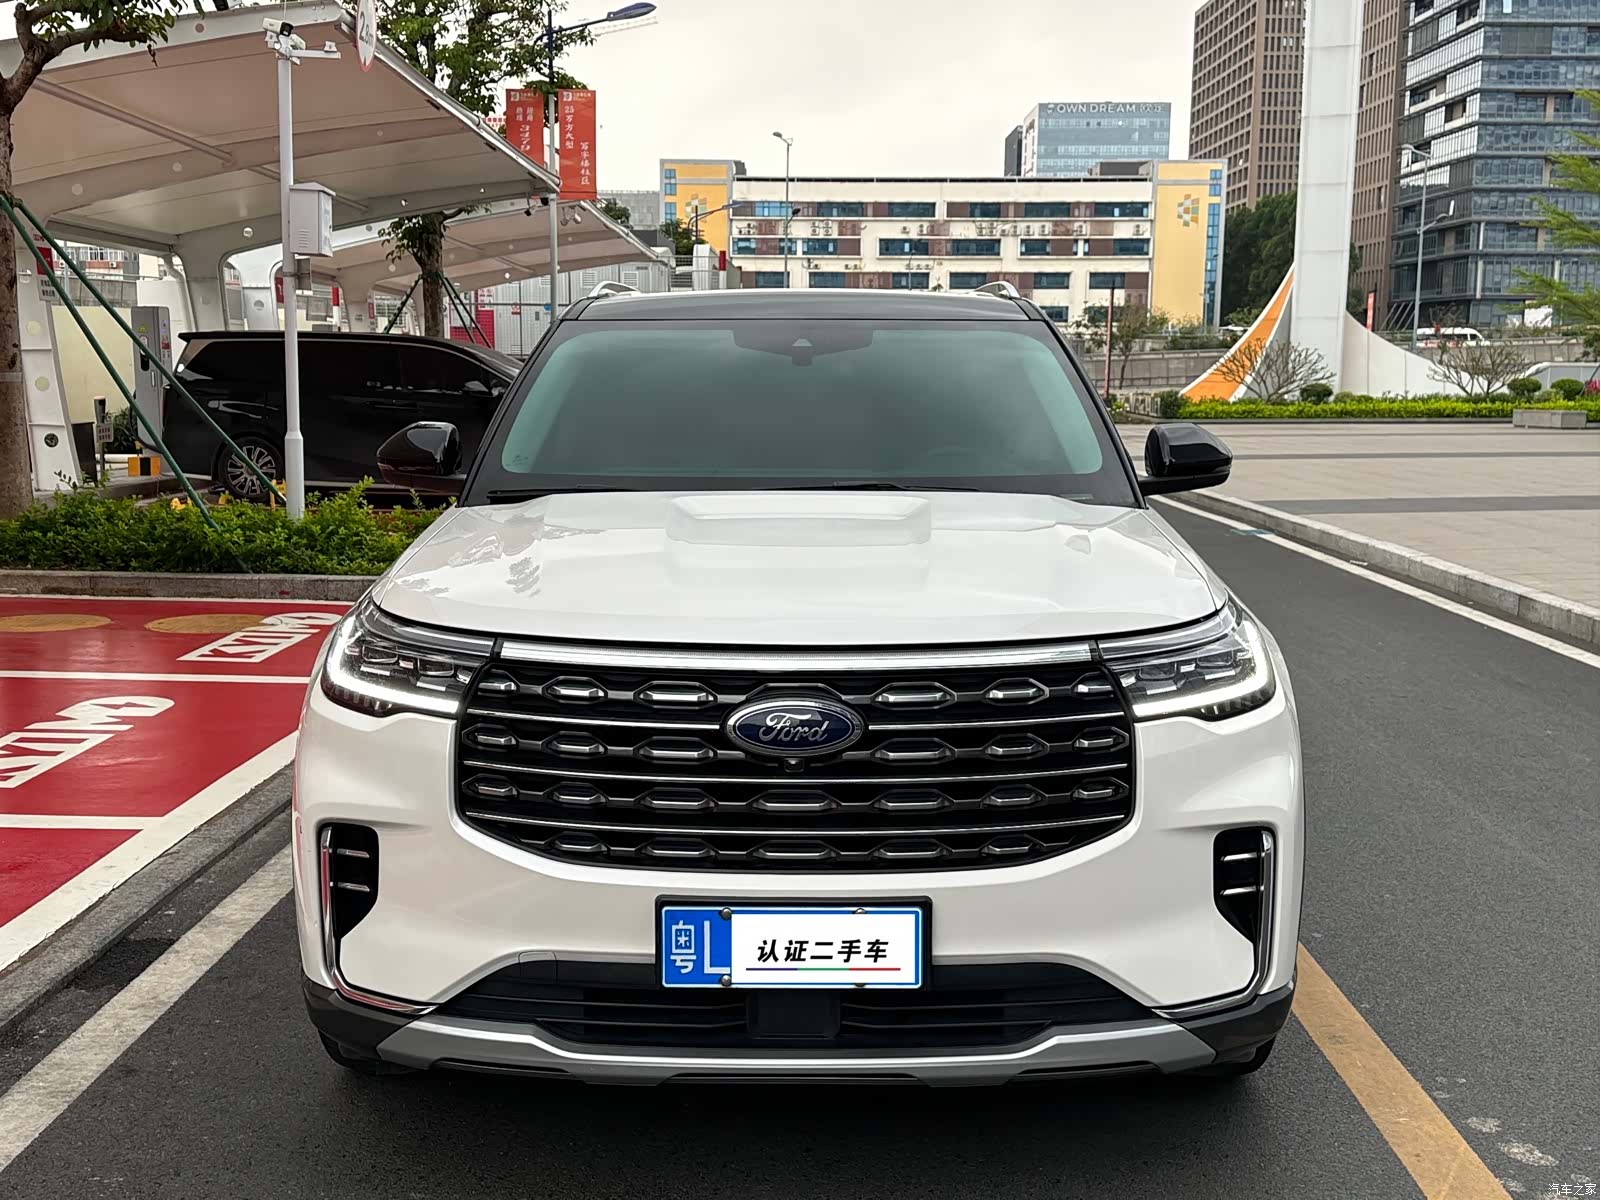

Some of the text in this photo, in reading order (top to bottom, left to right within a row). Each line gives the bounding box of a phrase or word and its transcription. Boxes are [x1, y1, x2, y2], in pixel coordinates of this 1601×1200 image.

[1056, 103, 1086, 113] OWN
[1089, 103, 1136, 113] DREAM
[758, 712, 830, 742] Ford
[669, 919, 731, 975] 粤L
